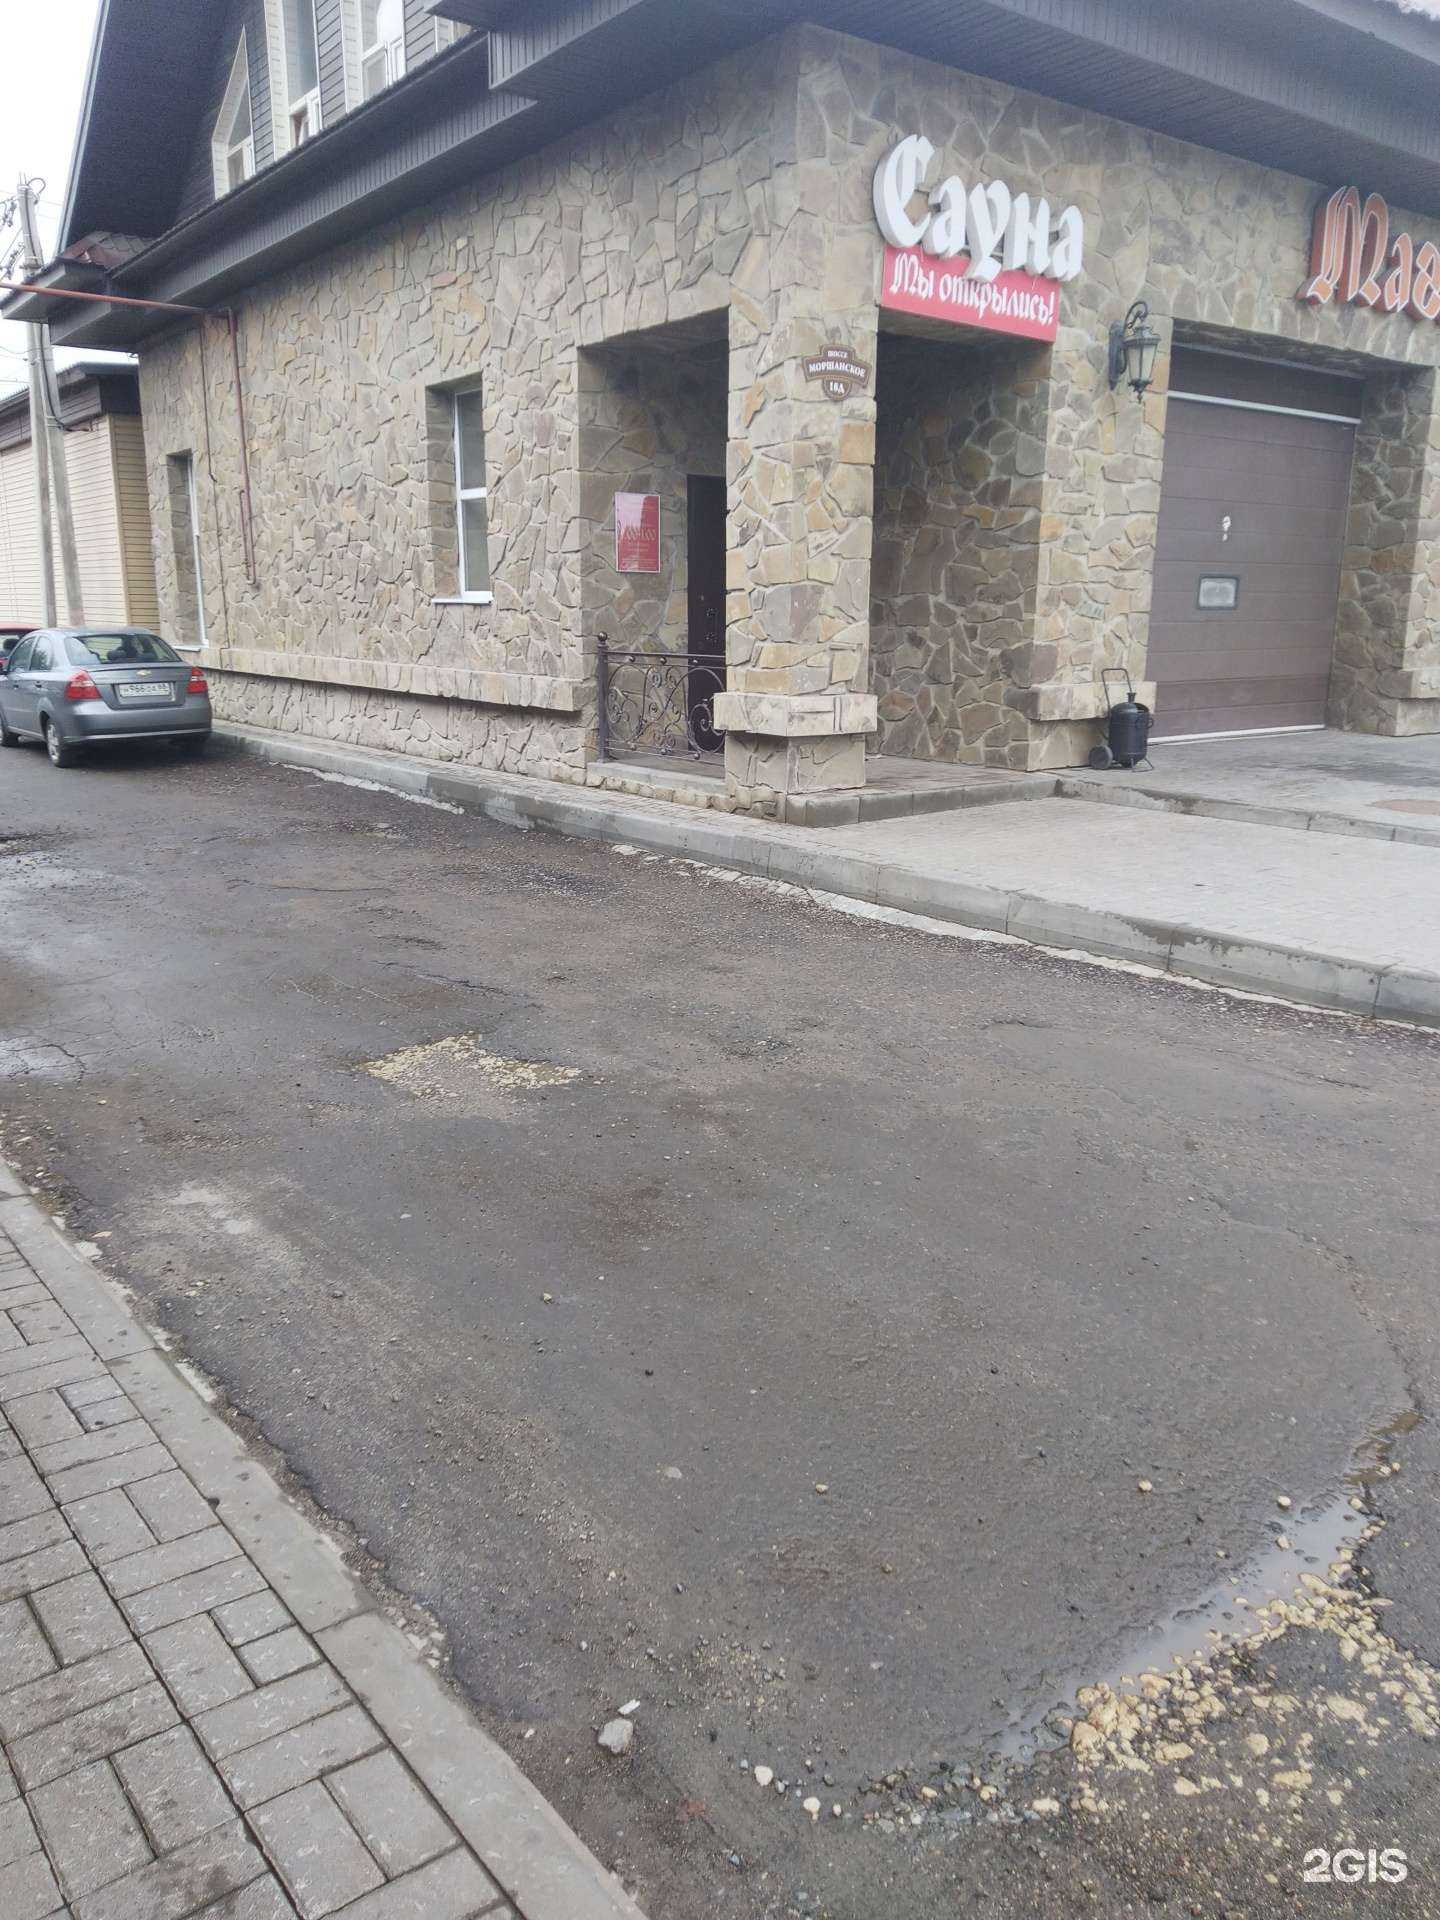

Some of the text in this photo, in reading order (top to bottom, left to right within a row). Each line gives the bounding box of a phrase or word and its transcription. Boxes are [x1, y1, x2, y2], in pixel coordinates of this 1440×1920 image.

[873, 134, 1084, 282] Сауна
[889, 252, 1056, 326] Мы открылись!
[808, 360, 867, 378] МОРШАНСКОЕ
